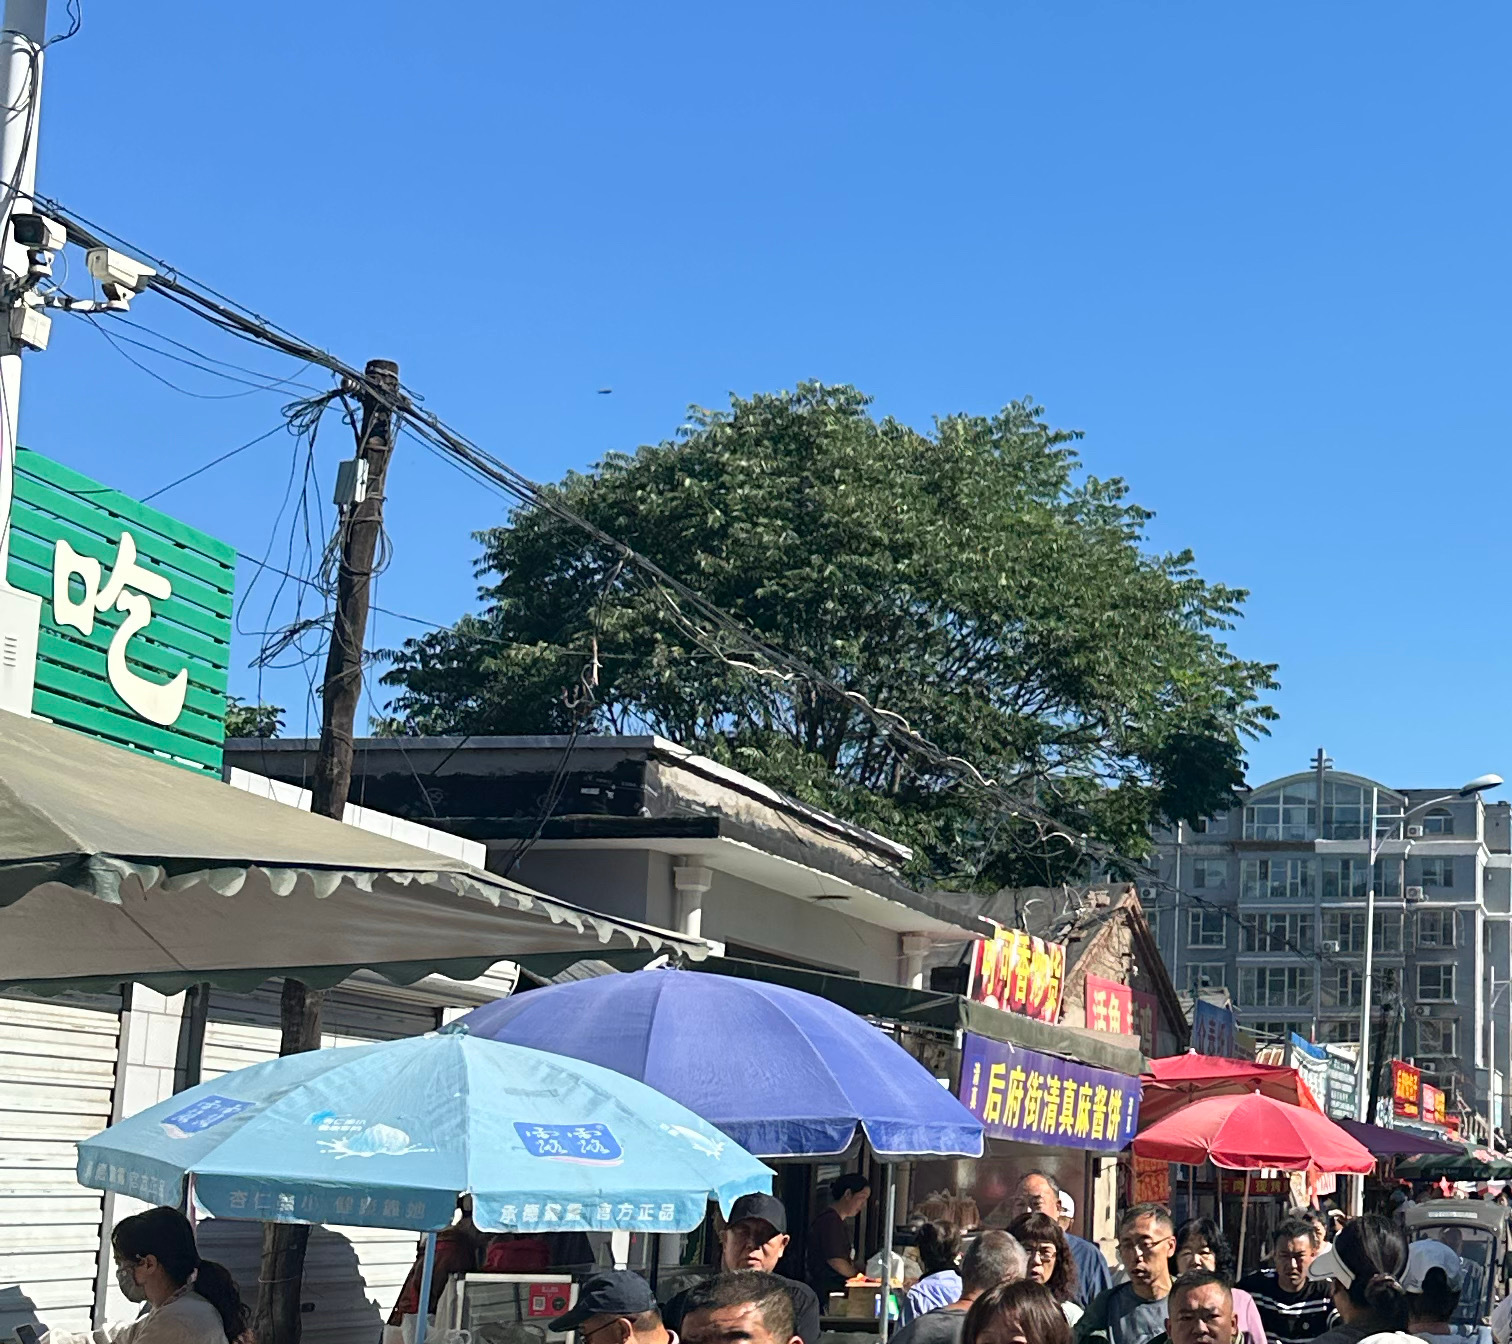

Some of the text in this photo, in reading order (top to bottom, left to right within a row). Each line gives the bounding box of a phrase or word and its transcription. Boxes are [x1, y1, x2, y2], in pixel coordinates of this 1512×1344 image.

[53, 531, 188, 727] 吃
[983, 1063, 1122, 1142] 后府街清真麻酱饼
[526, 1126, 609, 1154] 露露
[596, 1202, 675, 1222] 官方正品
